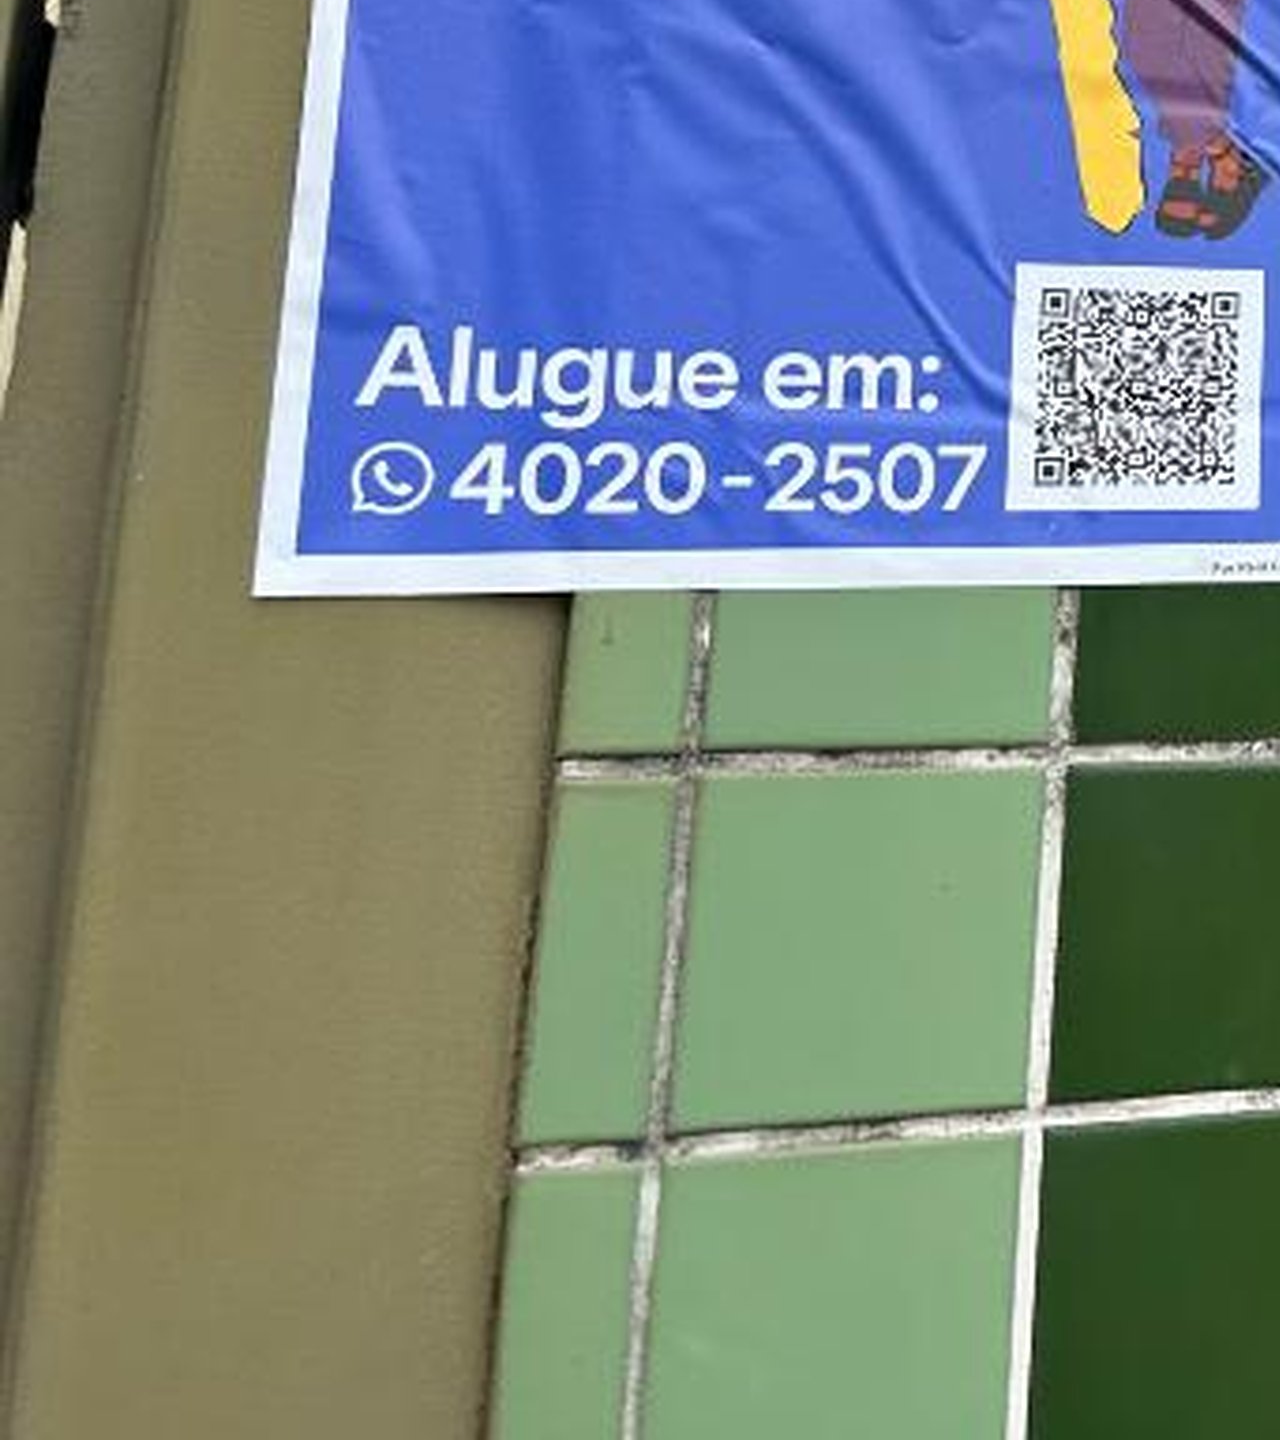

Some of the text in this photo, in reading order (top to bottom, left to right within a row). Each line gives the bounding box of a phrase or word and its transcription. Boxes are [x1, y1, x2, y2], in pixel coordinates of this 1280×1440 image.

[355, 323, 941, 430] Alugue em:
[449, 440, 989, 515] 4020-2507
